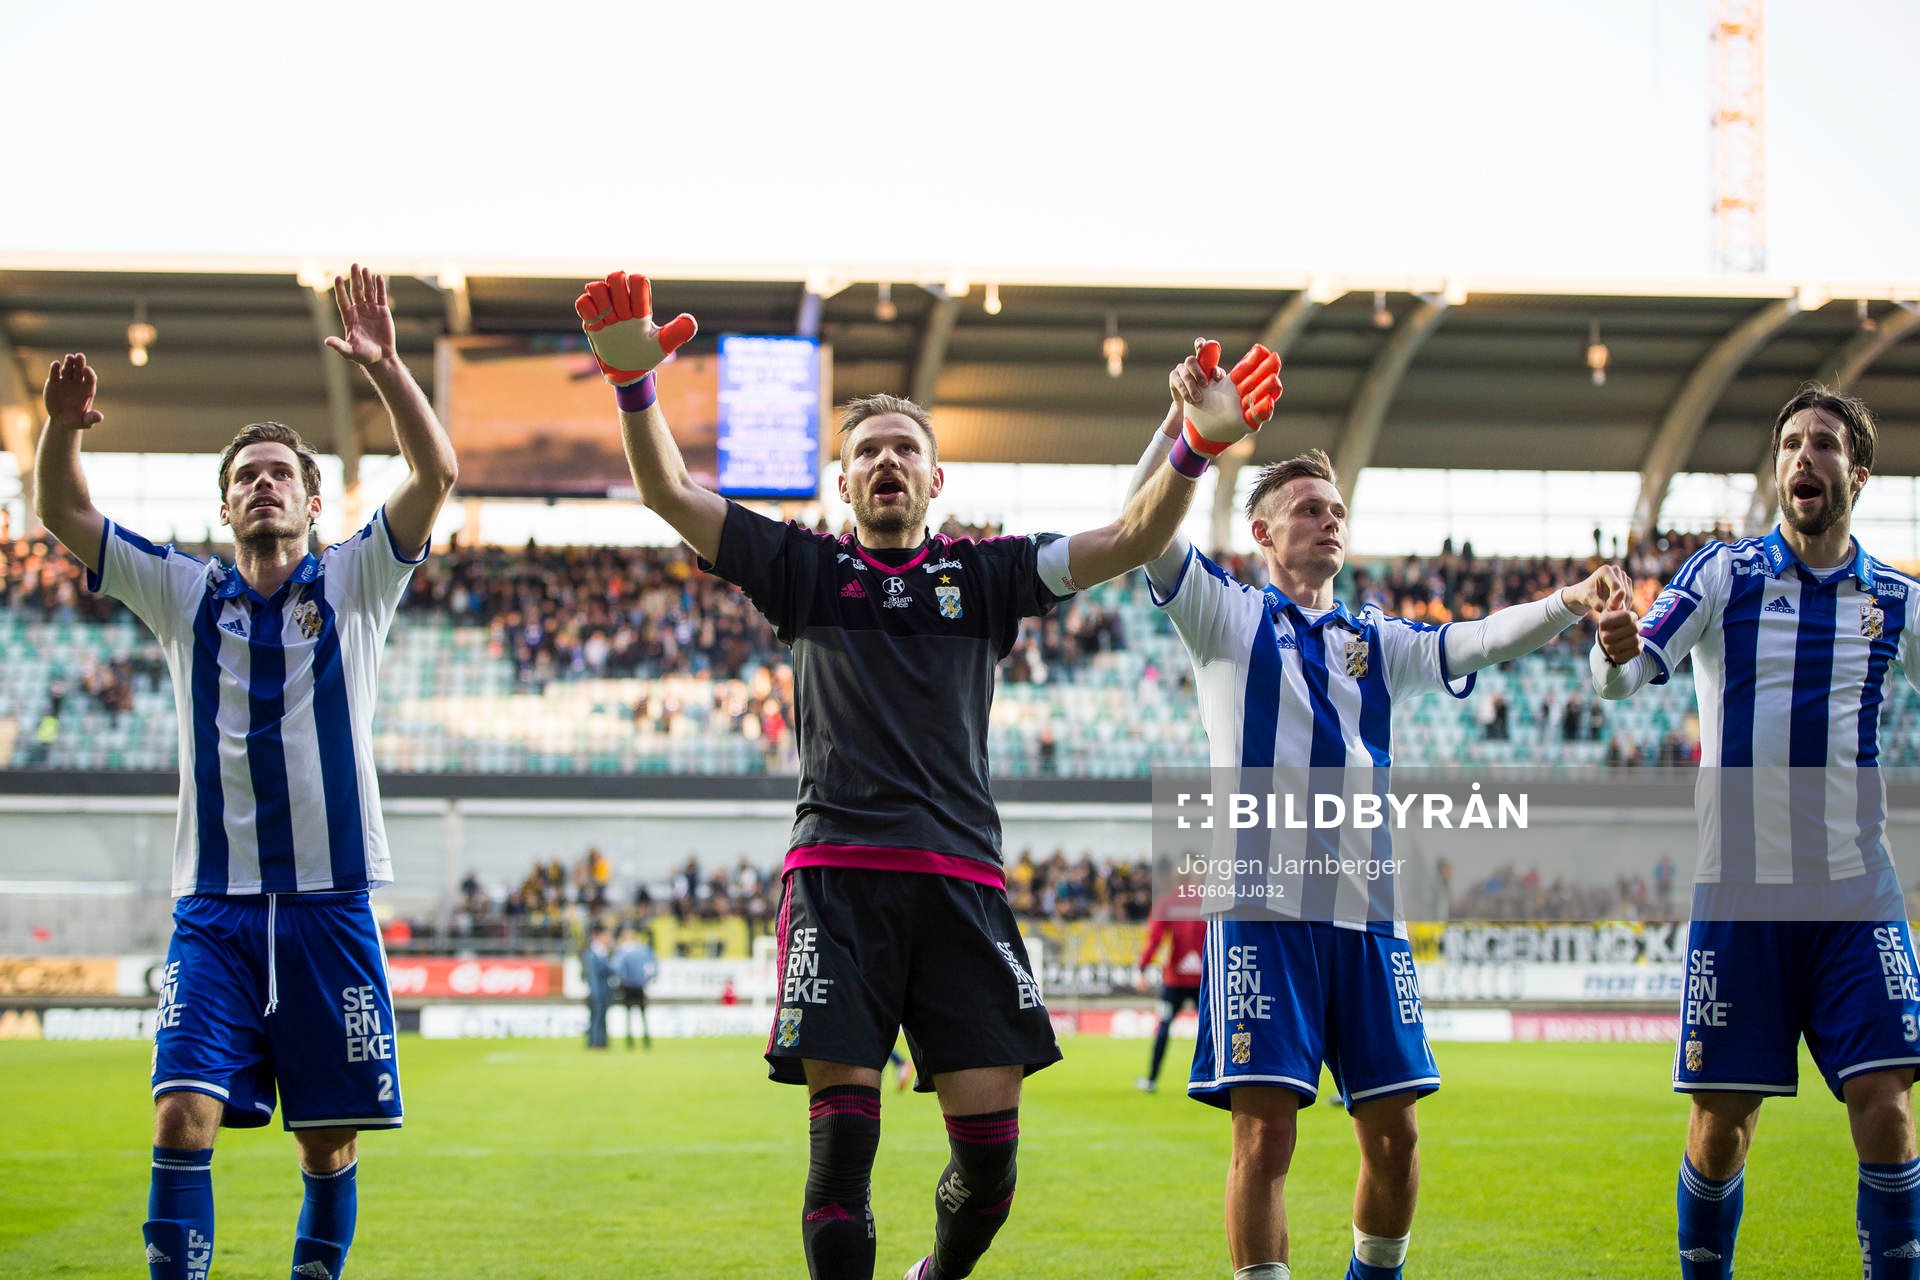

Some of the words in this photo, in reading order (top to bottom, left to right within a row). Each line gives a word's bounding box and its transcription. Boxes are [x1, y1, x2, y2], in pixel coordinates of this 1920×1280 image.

[1877, 582, 1906, 593] INTER
[1878, 590, 1905, 600] SPORT
[1764, 605, 1796, 615] adidas
[792, 927, 818, 953] SE
[1873, 926, 1904, 951] SE
[786, 952, 819, 978] RN
[1227, 945, 1258, 971] SE
[1390, 951, 1414, 976] SE
[1689, 949, 1715, 975] SE
[1879, 951, 1913, 976] RN
[783, 976, 829, 1004] EKE
[1226, 970, 1261, 995] RN
[1394, 975, 1421, 1000] RN
[1688, 974, 1717, 1001] RN
[342, 985, 375, 1012] SE
[1227, 994, 1271, 1021] EKE
[344, 1010, 381, 1037] RN
[1686, 1000, 1728, 1027] EKE
[347, 1034, 393, 1063] EKE
[377, 1072, 394, 1102] 2
